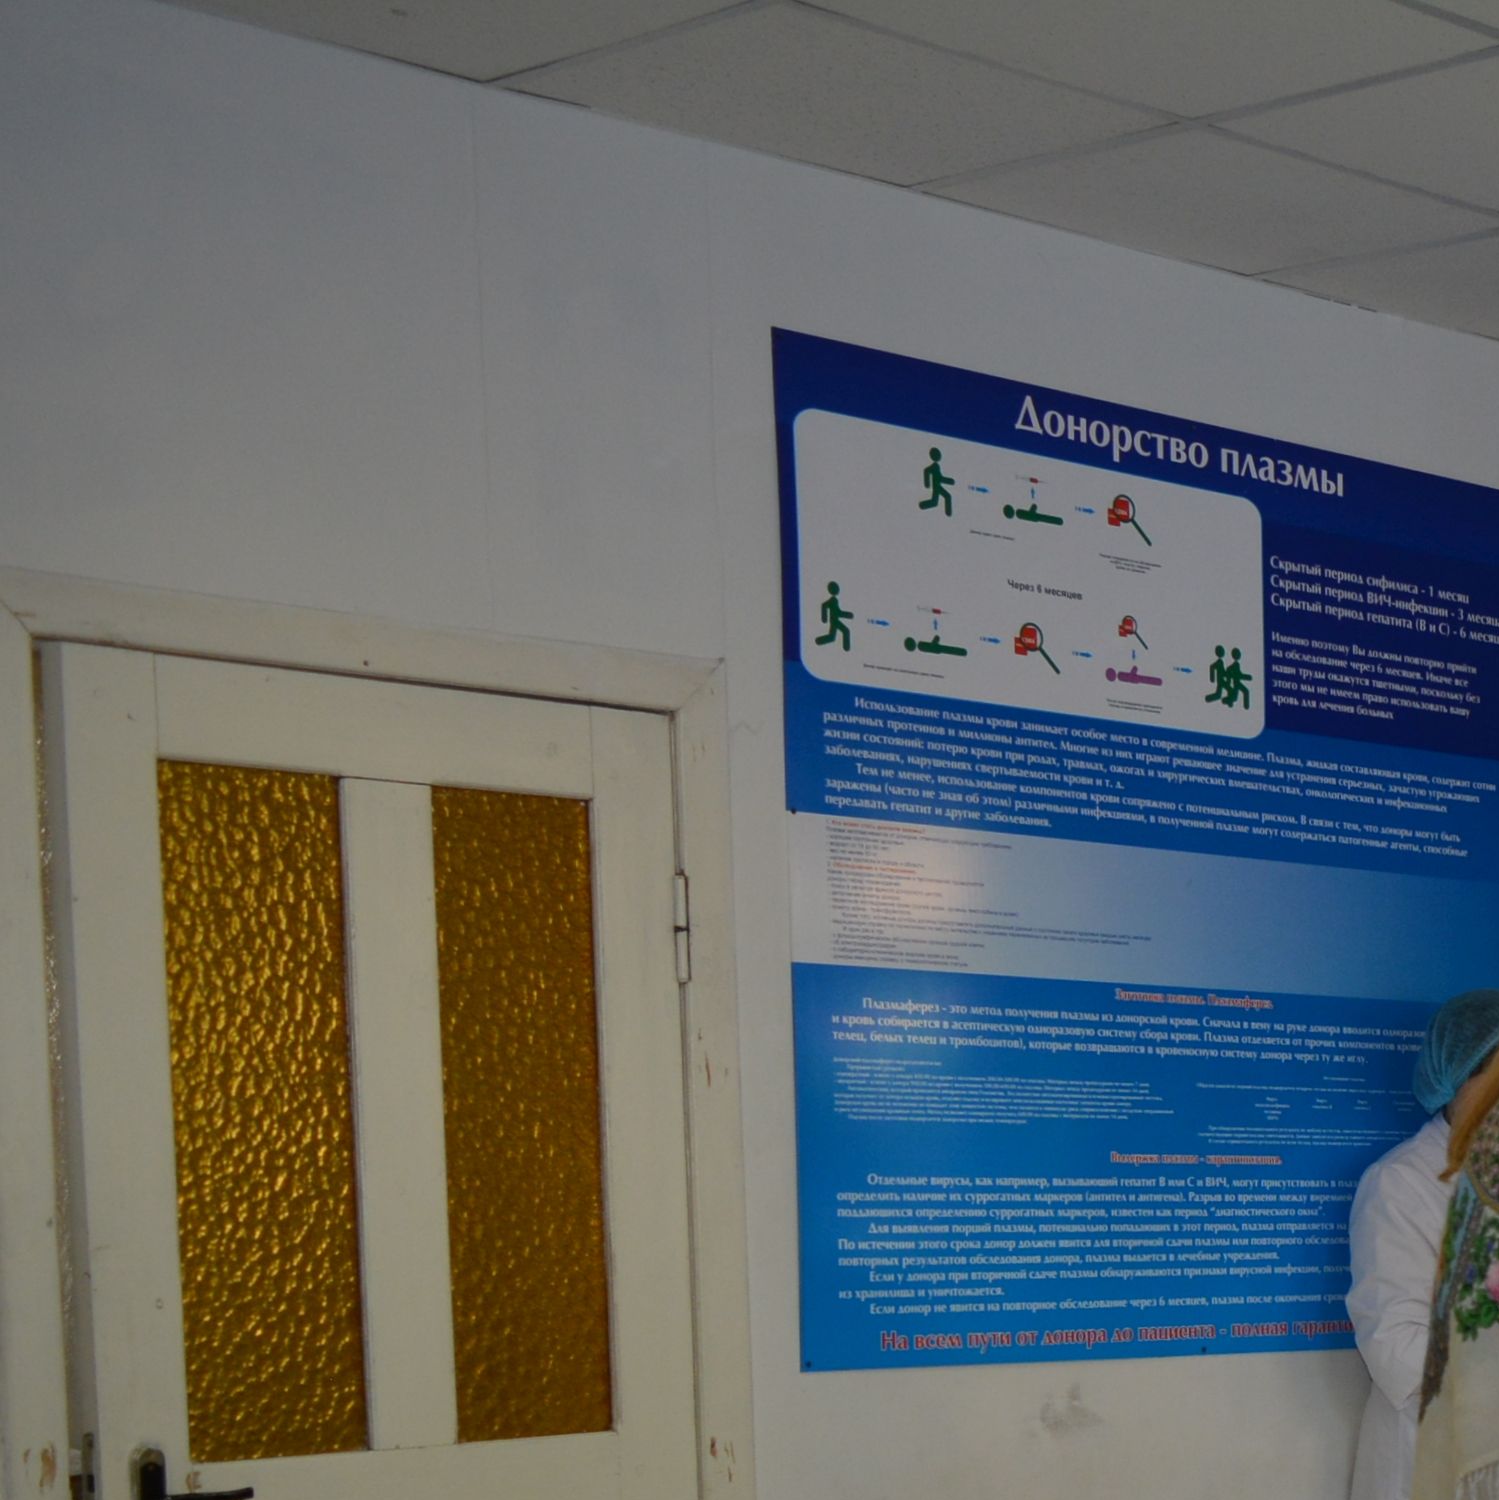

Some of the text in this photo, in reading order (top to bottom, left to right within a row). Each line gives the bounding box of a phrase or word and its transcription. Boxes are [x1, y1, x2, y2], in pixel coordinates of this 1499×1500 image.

[1014, 392, 1344, 498] Донорство плазмы
[1007, 578, 1035, 593] Через
[1043, 586, 1083, 601] месяцев
[1269, 554, 1322, 577] Скрытый
[1323, 568, 1364, 585] период
[1365, 574, 1419, 595] сифилиса
[1428, 584, 1433, 598] 1
[1437, 589, 1469, 605] месяц
[1269, 573, 1322, 595] Скрытый
[1324, 586, 1364, 603] период
[1366, 591, 1448, 618] ВИЧ-инфекции
[1457, 608, 1464, 621] 3
[1270, 592, 1322, 614] Скрытый
[1324, 604, 1364, 621] период
[1366, 612, 1412, 629] гепатита
[1428, 623, 1436, 634] и
[1459, 626, 1467, 639] 6
